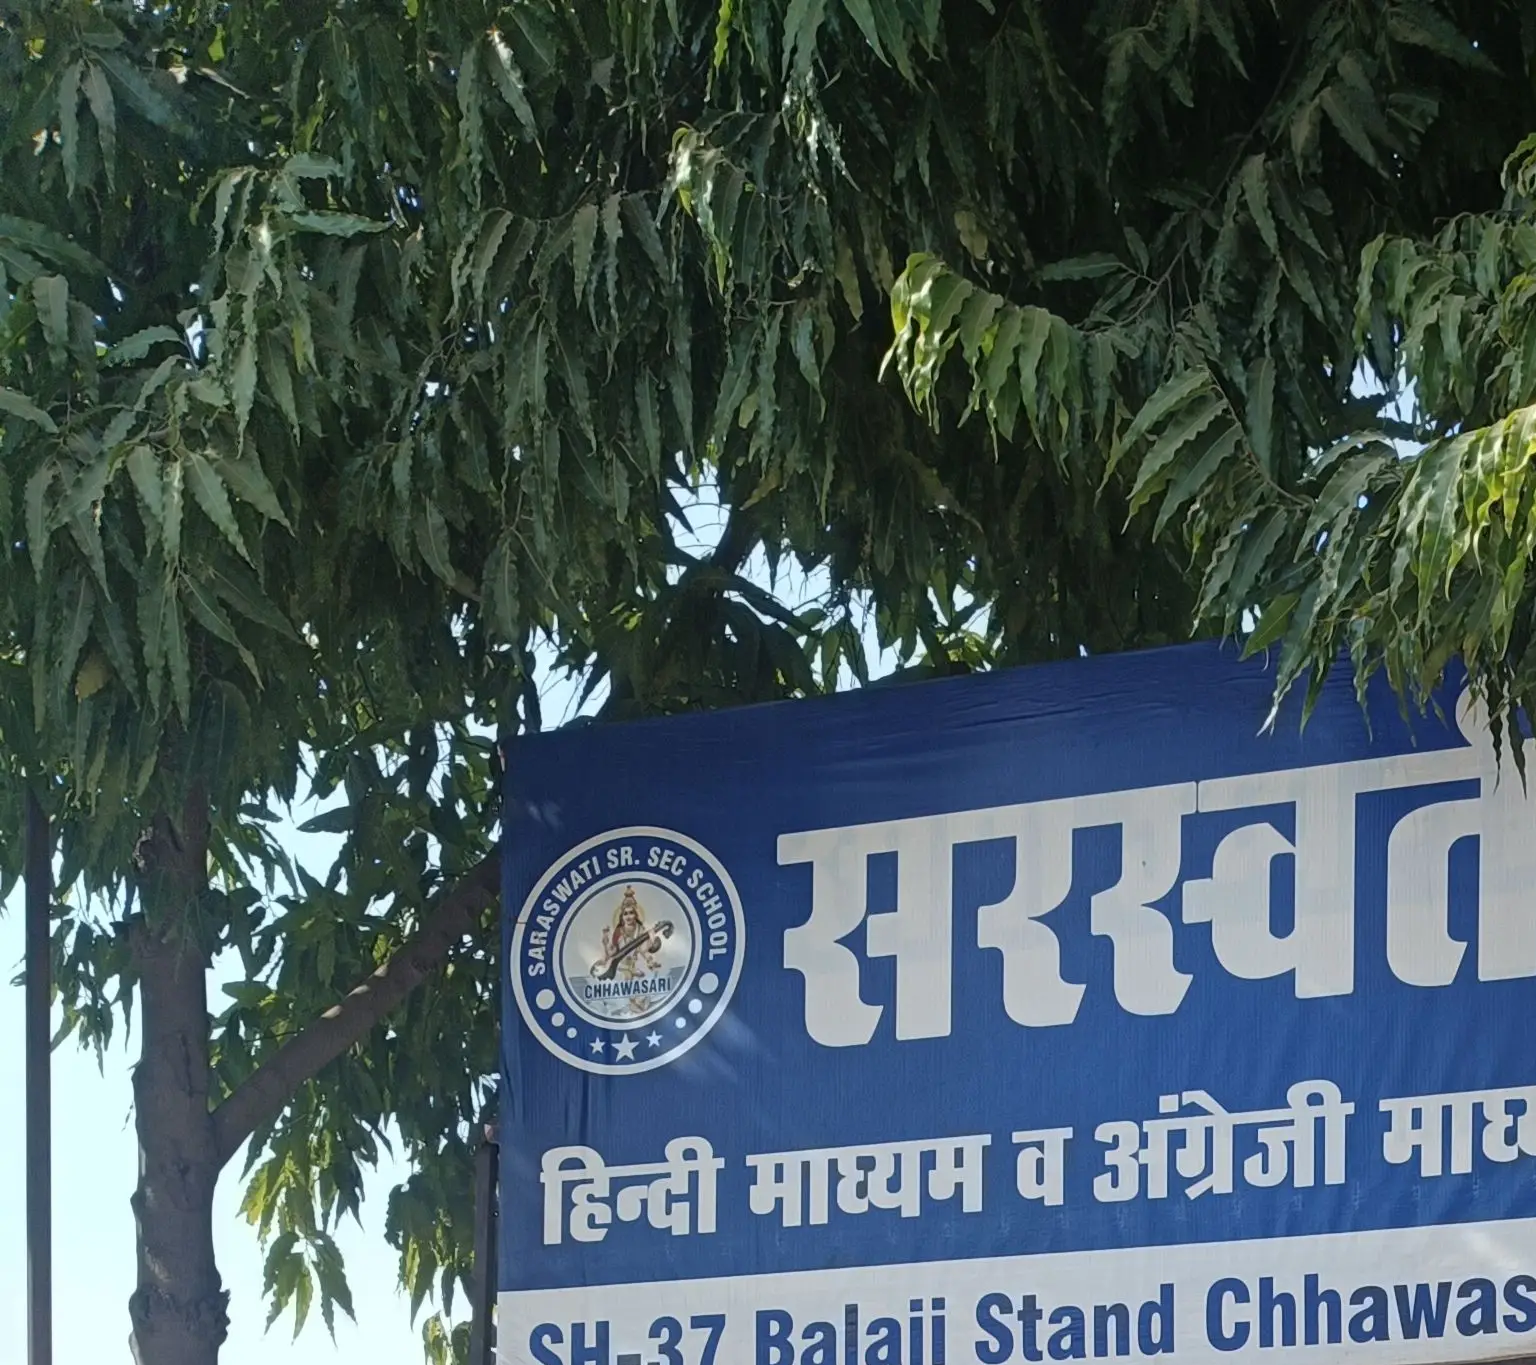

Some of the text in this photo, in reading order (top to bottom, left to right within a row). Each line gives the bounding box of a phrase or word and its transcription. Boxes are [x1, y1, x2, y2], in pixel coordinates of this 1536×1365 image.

[528, 846, 728, 977] SARASWATI SR. SEC SCHOOL
[584, 977, 671, 999] CHHAWASARI
[539, 1135, 726, 1245] हिन्दी
[1011, 1126, 1074, 1207] व
[1093, 1079, 1355, 1203] अंग्रेजी
[974, 1282, 1175, 1365] Stand
